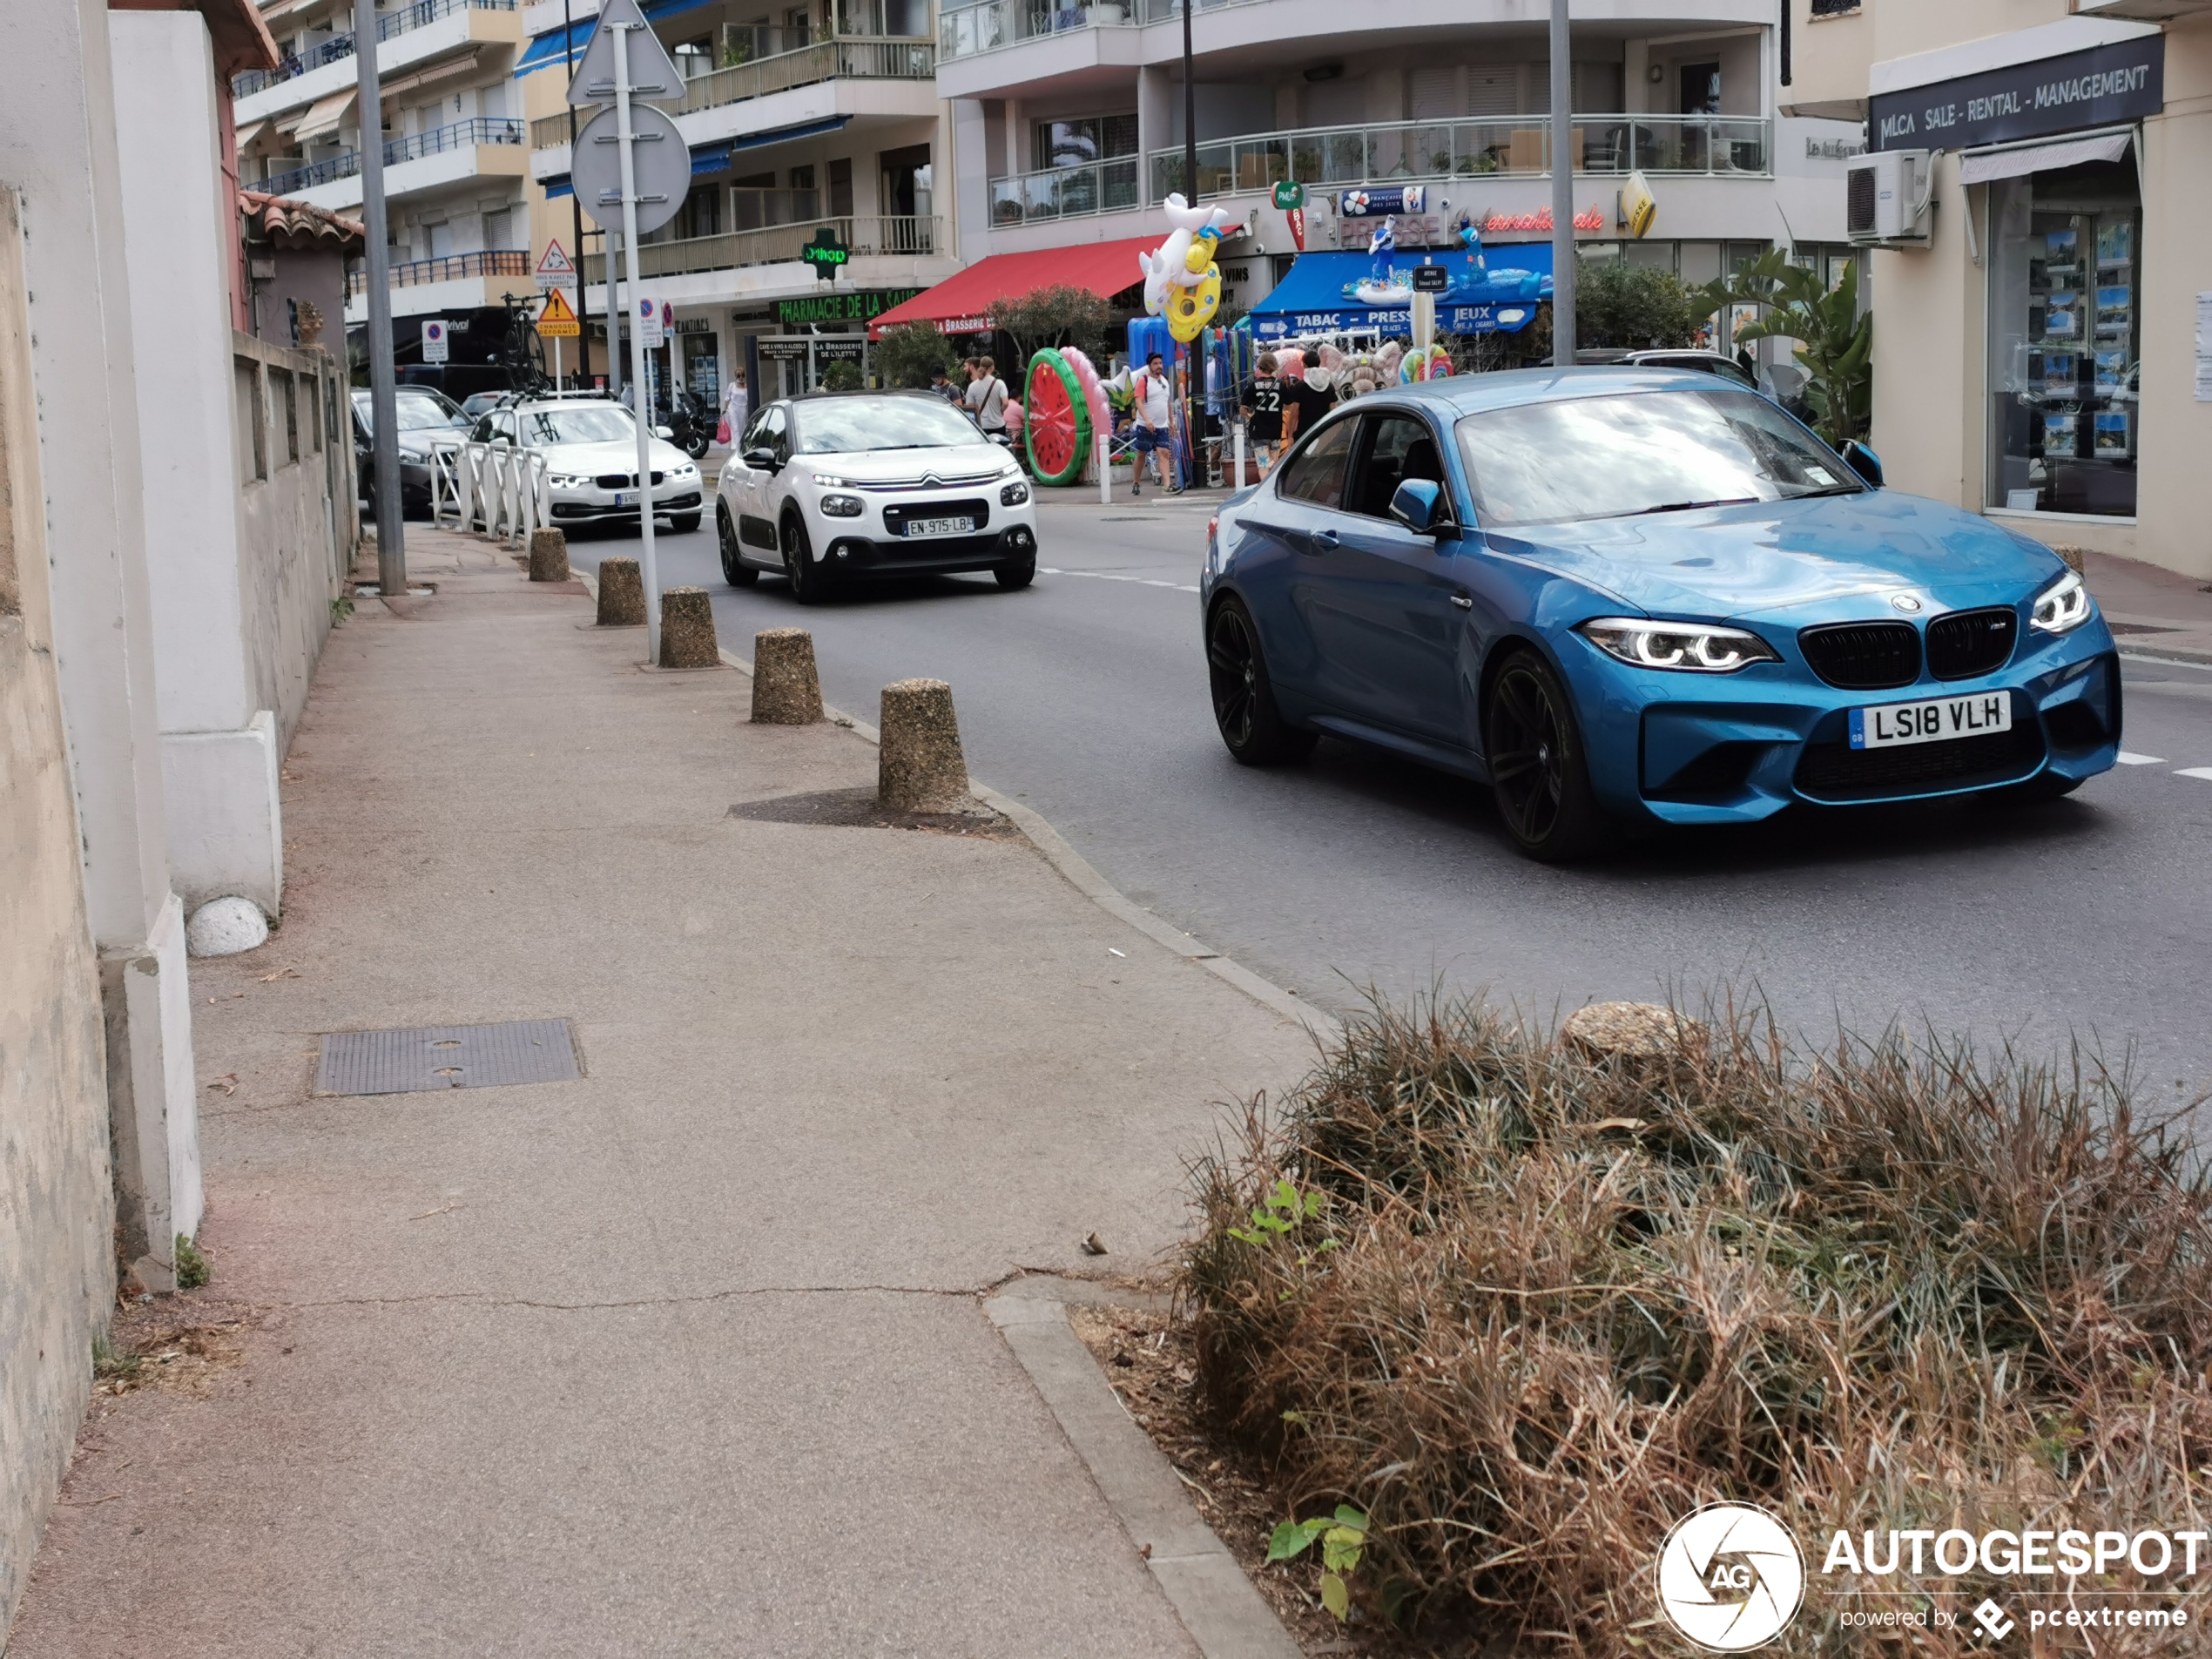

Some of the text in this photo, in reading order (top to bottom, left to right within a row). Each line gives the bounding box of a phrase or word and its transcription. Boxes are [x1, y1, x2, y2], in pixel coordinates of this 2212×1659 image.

[1925, 104, 1955, 131] SALE
[1967, 91, 2020, 123] RENTAL
[2034, 64, 2148, 110] MANAGEMENT
[1278, 191, 1291, 201] PMU
[1225, 266, 1249, 282] VINS
[779, 297, 842, 322] PHARMACIE
[847, 295, 861, 318] DE
[866, 293, 880, 316] LA
[1294, 313, 1340, 327] TABAC
[1367, 310, 1412, 323] PRESS
[1453, 307, 1490, 323] JEUX
[945, 318, 984, 331] BRASSERIE
[1255, 391, 1280, 412] 22
[1875, 698, 2000, 740] LS18 VLH
[1851, 733, 1863, 743] GB
